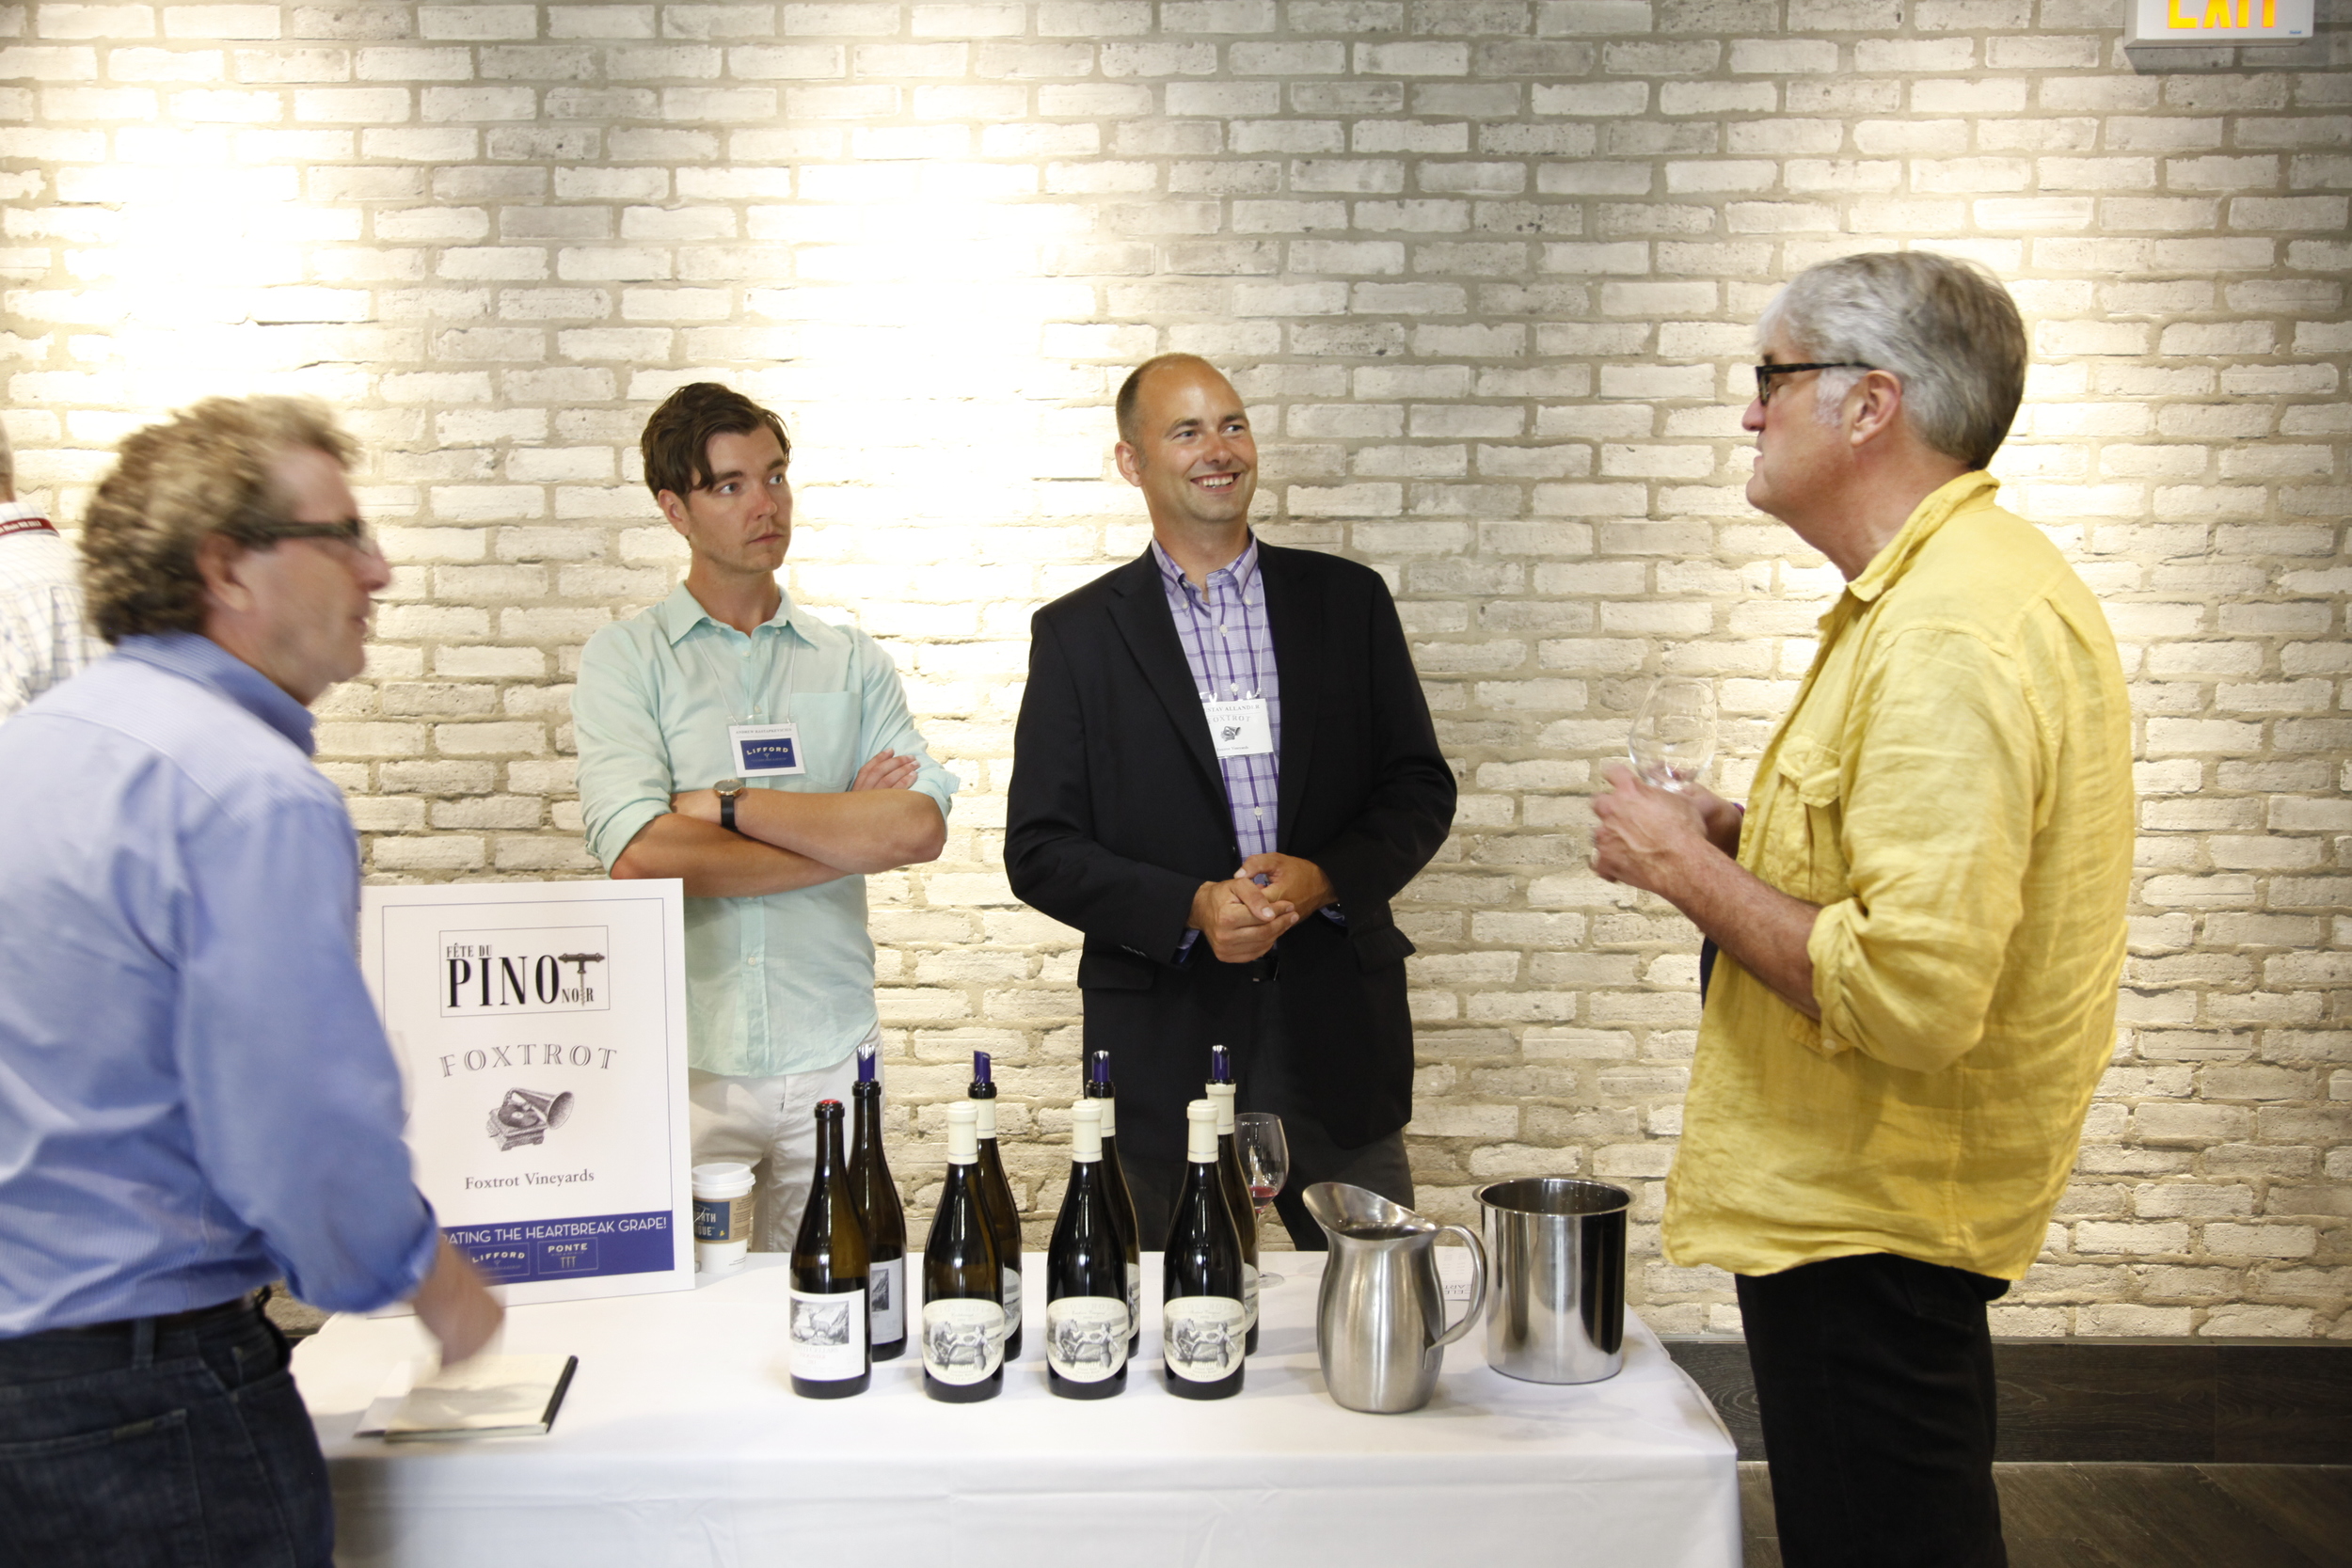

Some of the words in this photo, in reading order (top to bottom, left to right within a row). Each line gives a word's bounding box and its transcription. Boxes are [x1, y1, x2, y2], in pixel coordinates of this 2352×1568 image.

[746, 746, 788, 755] LIFFORD
[446, 942, 474, 958] FÊTE
[479, 944, 492, 957] DU
[438, 1043, 617, 1078] FOXTROT
[465, 1176, 519, 1190] Foxtrot
[524, 1168, 595, 1187] Vineyards
[495, 1227, 522, 1242] THE
[525, 1220, 614, 1239] HEARTBREAK
[618, 1217, 667, 1232] GRAPE!
[548, 1243, 588, 1253] PONTE
[472, 1251, 525, 1263] LIFFORD
